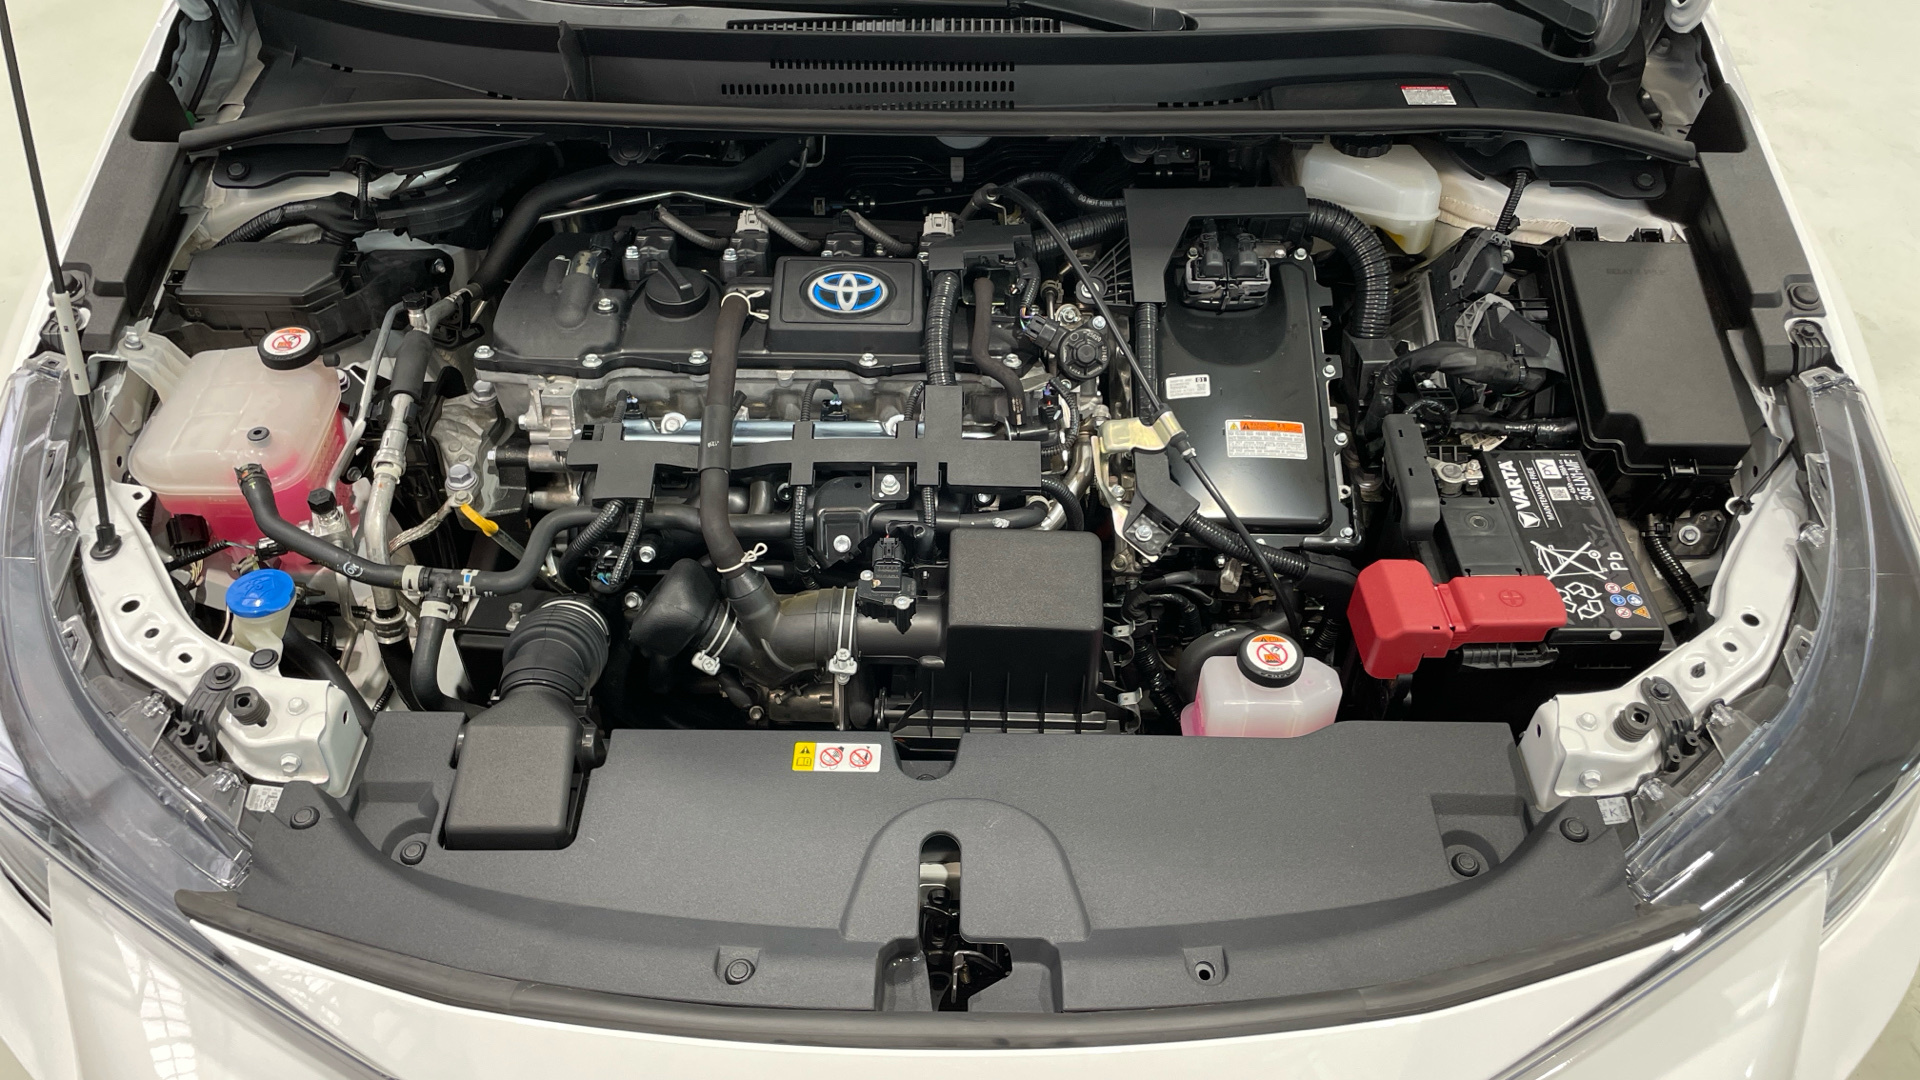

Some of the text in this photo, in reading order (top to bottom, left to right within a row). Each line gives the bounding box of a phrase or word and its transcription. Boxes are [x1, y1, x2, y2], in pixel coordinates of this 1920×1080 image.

[1539, 461, 1558, 476] PY
[1563, 459, 1589, 486] LN1-MF
[1499, 460, 1531, 510] VARTA
[1525, 467, 1556, 521] MAINTENANCE FREE
[1576, 487, 1596, 501] 345
[1606, 551, 1629, 571] Pb
